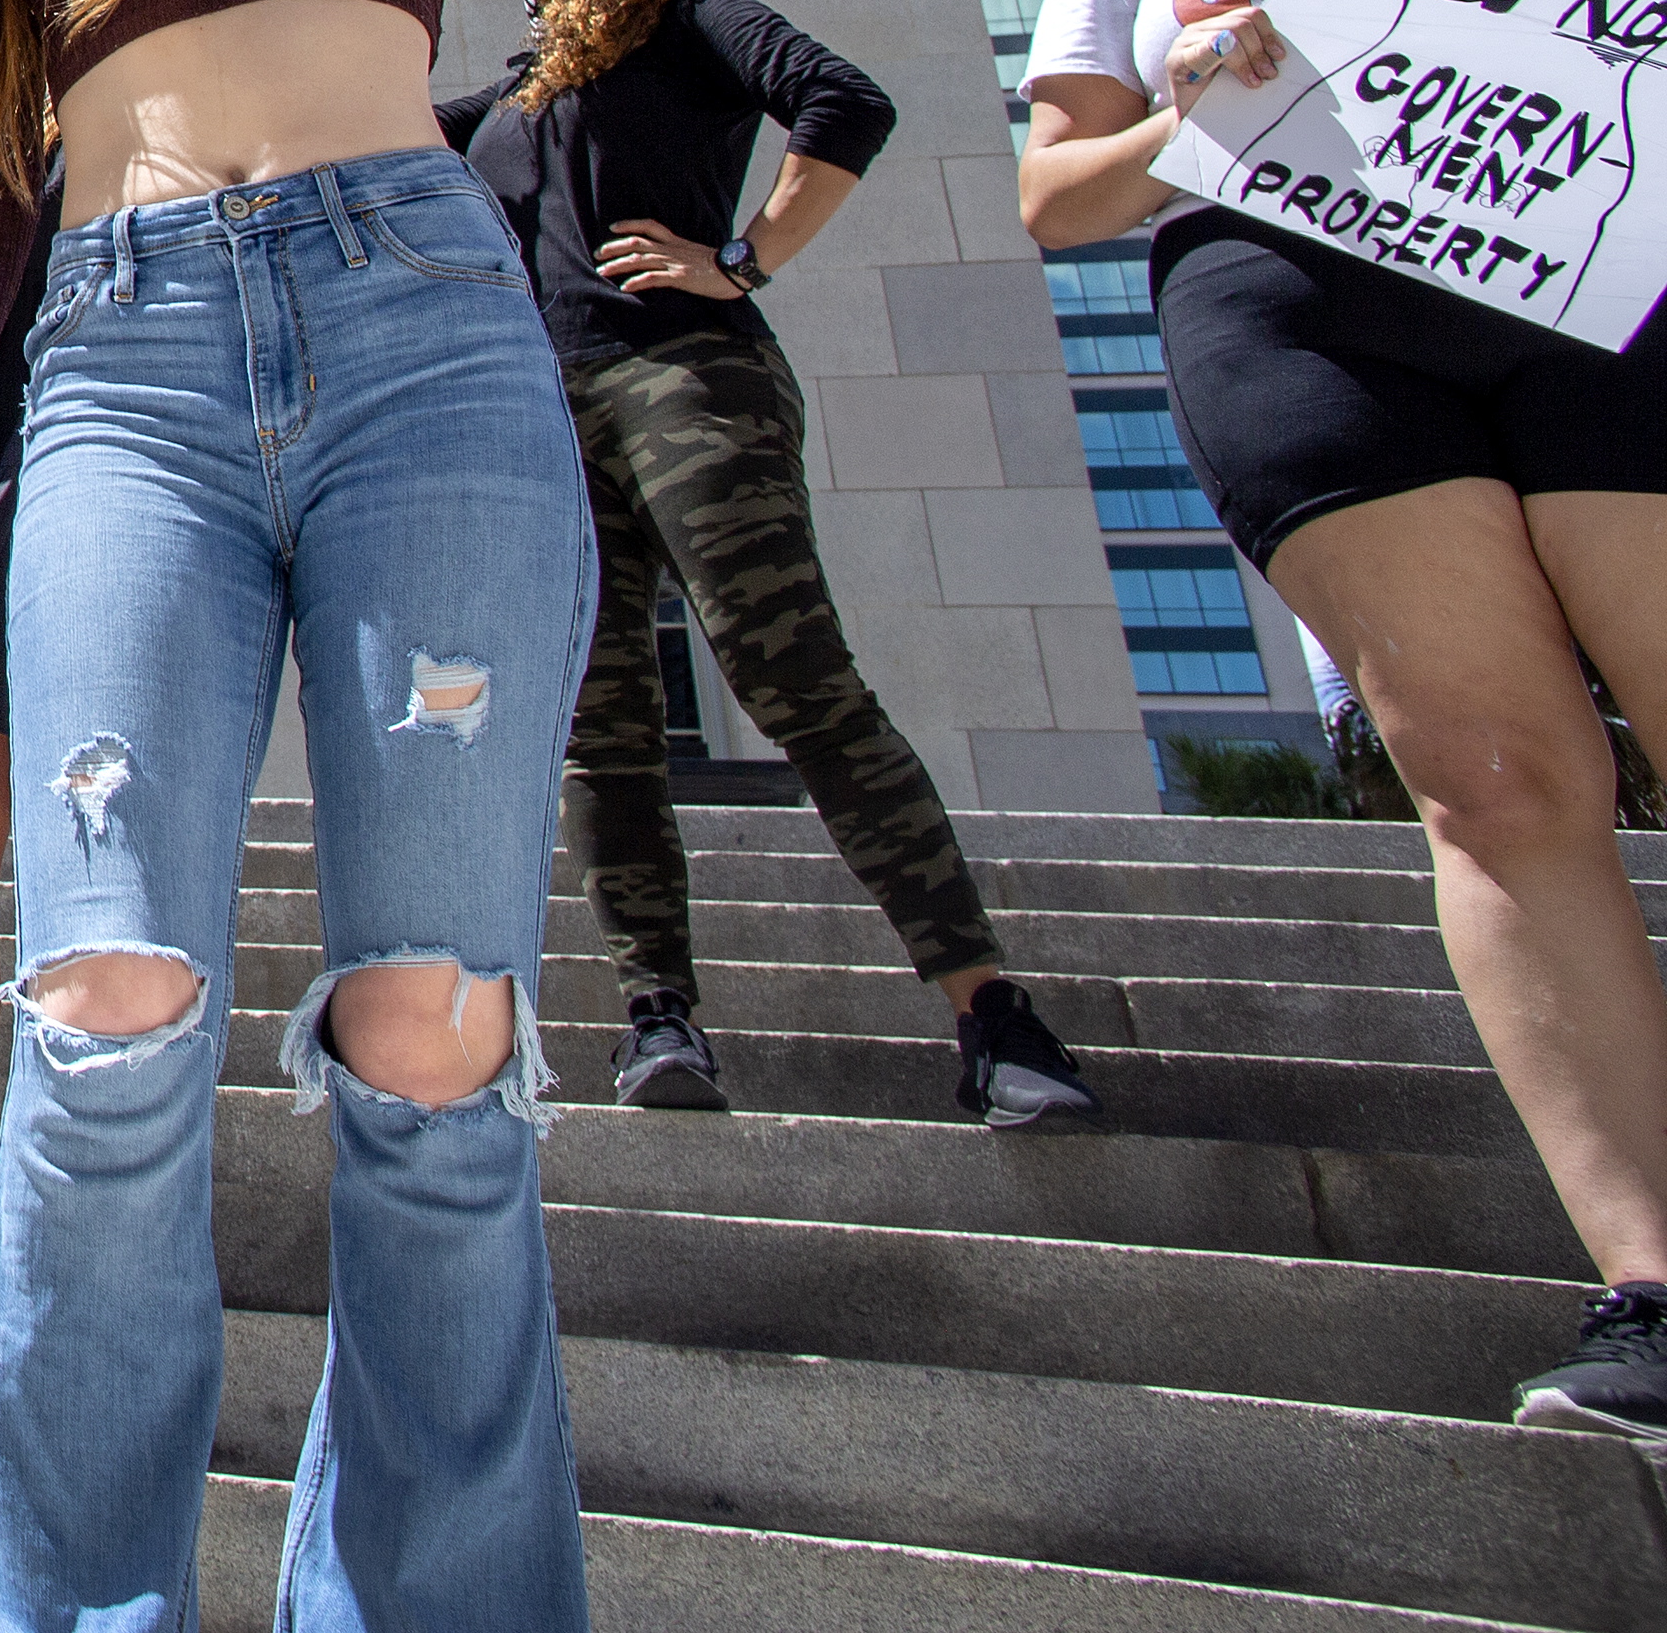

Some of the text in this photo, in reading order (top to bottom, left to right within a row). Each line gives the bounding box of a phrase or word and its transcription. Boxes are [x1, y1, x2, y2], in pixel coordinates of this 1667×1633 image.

[1356, 52, 1615, 178] GOVERN
[1373, 121, 1566, 220] MENT
[1239, 160, 1567, 301] PROPERTY
